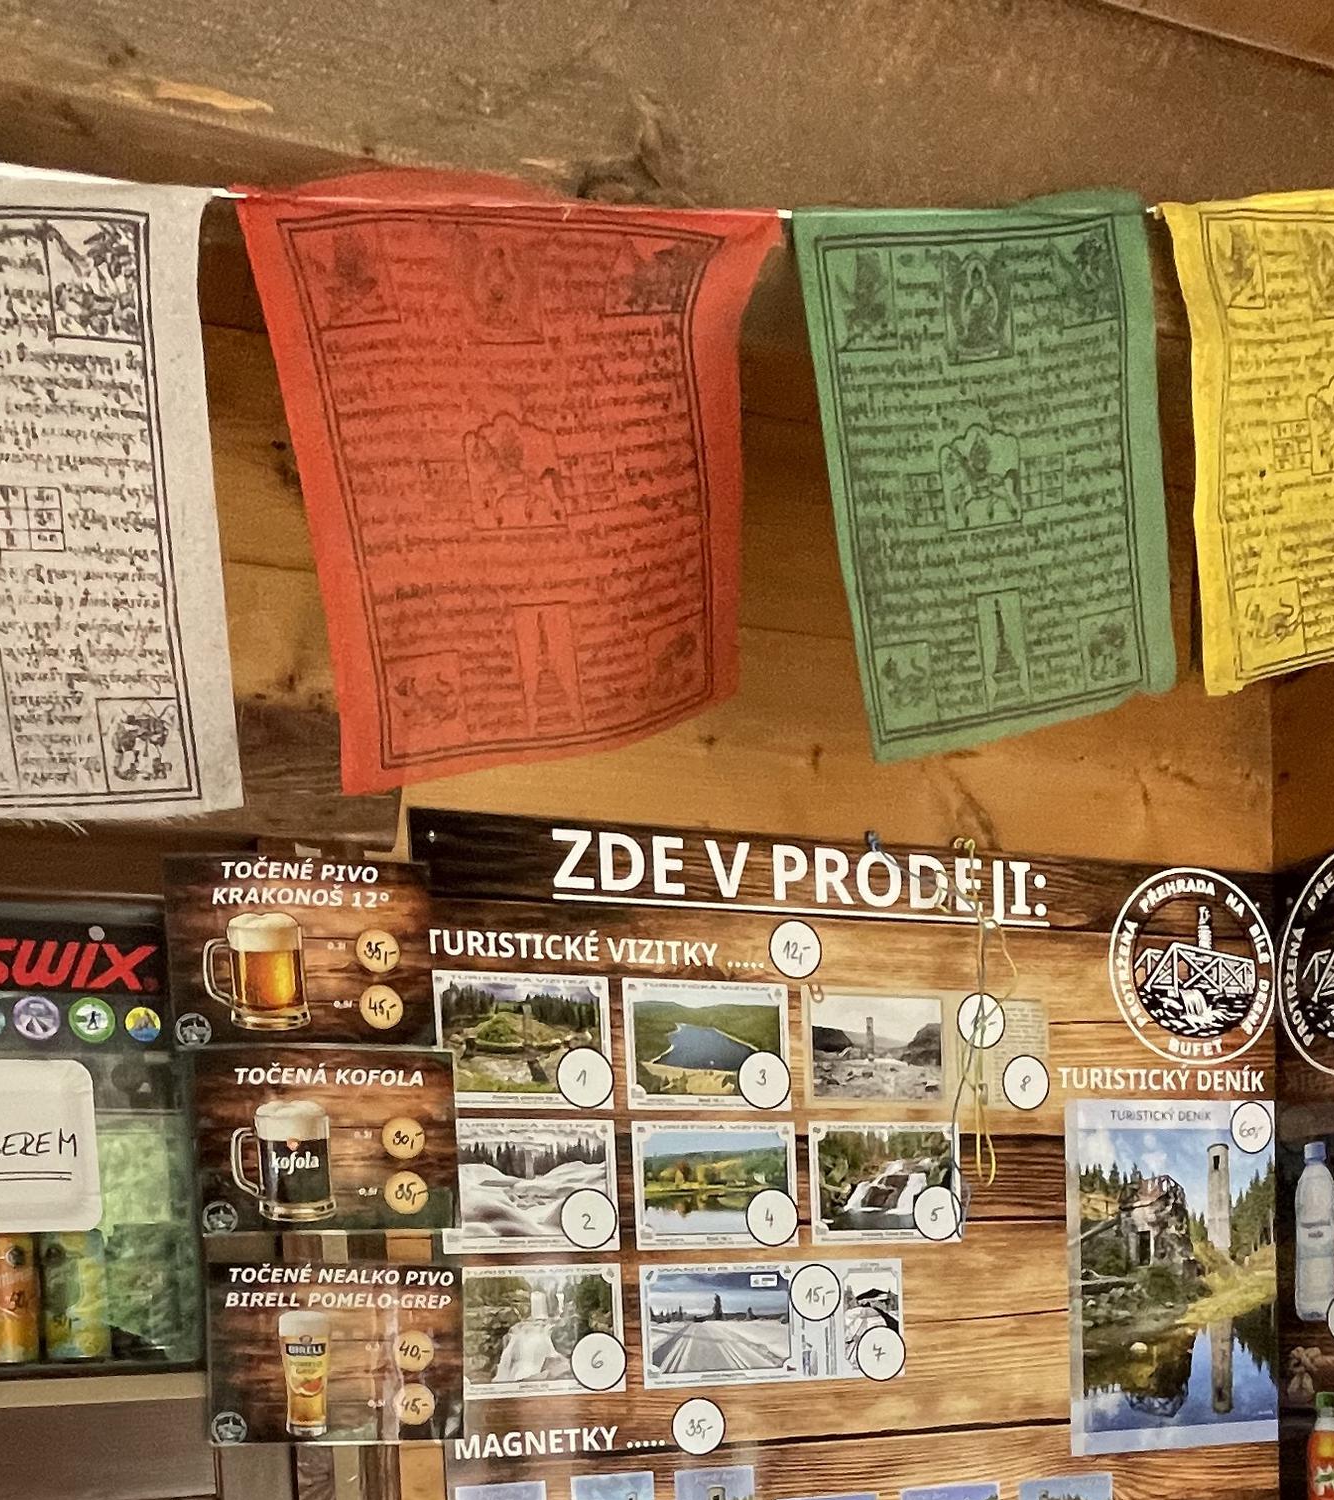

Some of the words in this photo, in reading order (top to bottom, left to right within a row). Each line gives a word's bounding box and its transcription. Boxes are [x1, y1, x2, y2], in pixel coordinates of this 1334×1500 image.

[221, 857, 314, 881] TOČENÉ
[321, 864, 379, 883] PIVO
[551, 828, 686, 894] ZDE
[703, 840, 751, 899] V
[771, 844, 1049, 922] PRODEJI:
[212, 884, 343, 907] KRAKONOŠ
[1139, 878, 1216, 915] PŘEHRADA
[1224, 893, 1246, 919] NA
[429, 927, 601, 962] TURISTICKÉ
[607, 937, 718, 968] VIZITKY
[1248, 922, 1269, 966] BÍLÉ
[1122, 919, 1148, 1030] PROTRŽENÁ
[1288, 926, 1317, 1048] PROTRŽENÁ
[368, 999, 397, 1020] 45,-
[1240, 977, 1269, 1036] DESNÉ
[1167, 1036, 1224, 1057] BUFET
[234, 1062, 327, 1085] TOČENÁ
[335, 1068, 424, 1087] KOFOLA
[1058, 1063, 1191, 1093] TURISTICKÝ
[1196, 1064, 1266, 1092] DENÍK
[1109, 1106, 1175, 1122] TURISTICKÝ
[1178, 1107, 1212, 1121] DENÍK
[271, 1151, 320, 1175] kofola
[581, 1212, 596, 1230] 2
[228, 1263, 312, 1284] TOČENÉ
[317, 1267, 400, 1285] NEALKO
[405, 1269, 455, 1287] PIVO
[225, 1292, 301, 1308] BIRELL
[307, 1292, 452, 1310] POMELO-GREP
[399, 1340, 430, 1360] 40,-
[591, 1350, 604, 1369] 6
[454, 1426, 619, 1461] MAGNETKY
